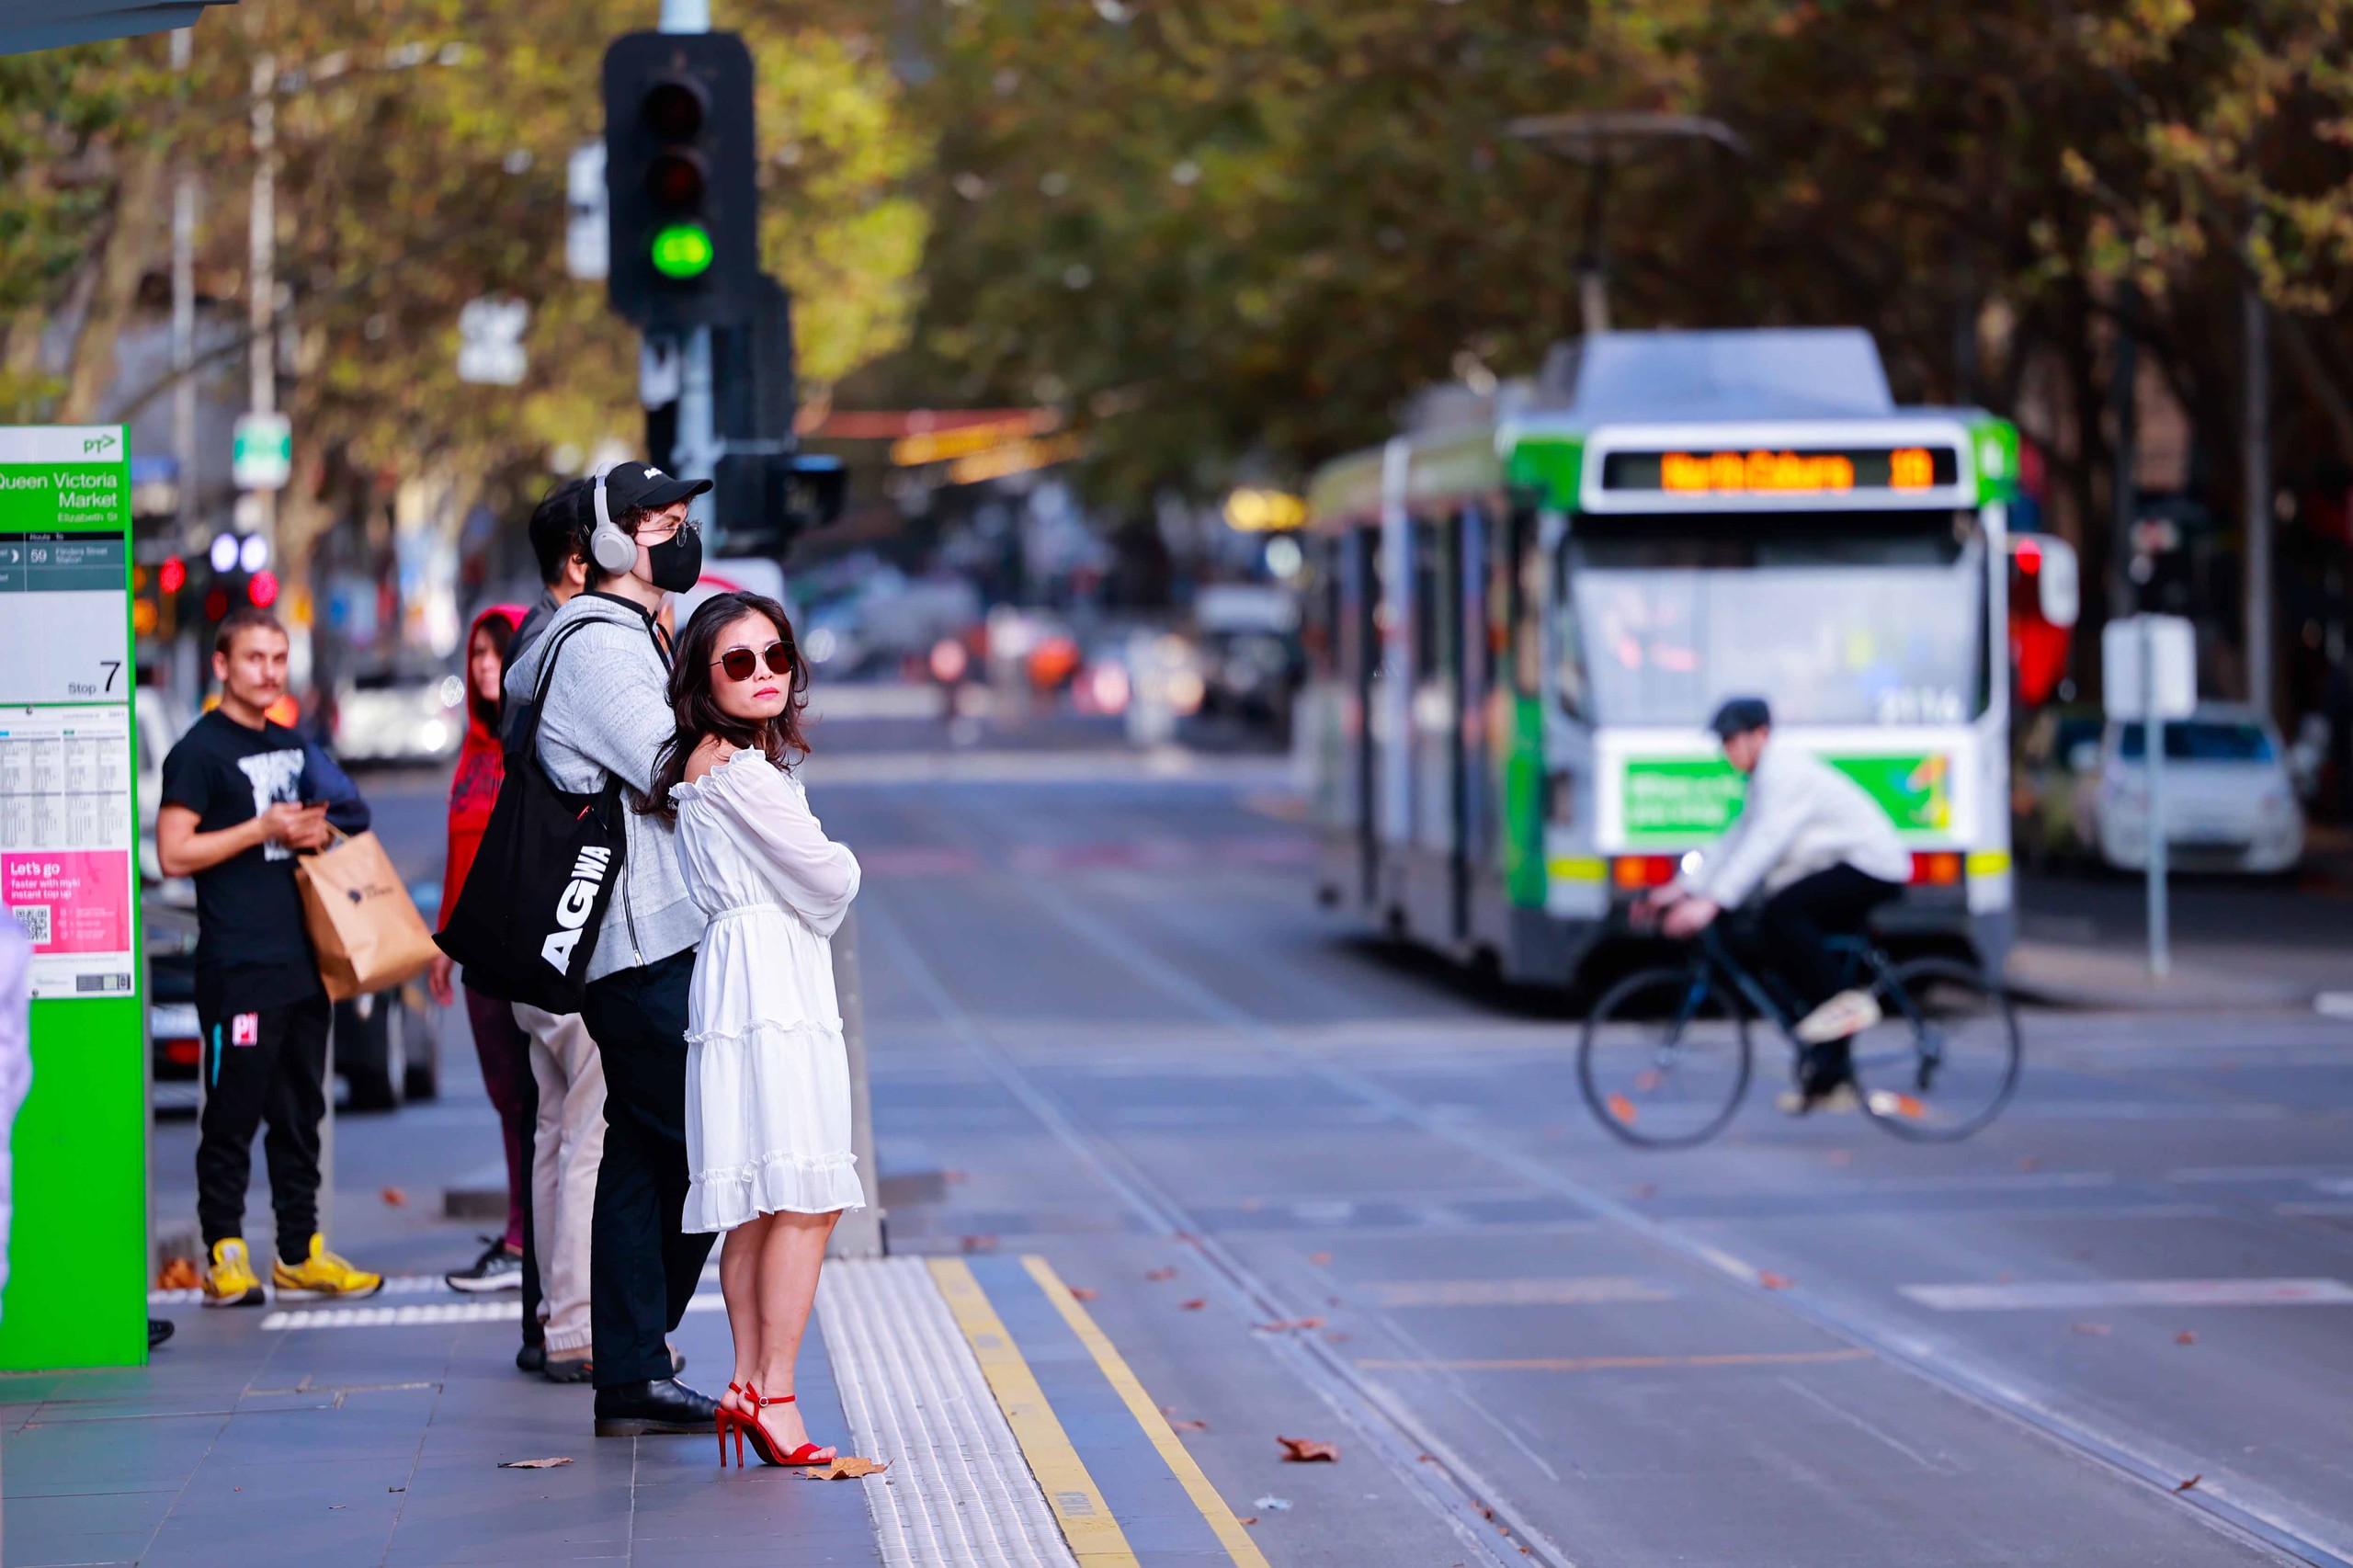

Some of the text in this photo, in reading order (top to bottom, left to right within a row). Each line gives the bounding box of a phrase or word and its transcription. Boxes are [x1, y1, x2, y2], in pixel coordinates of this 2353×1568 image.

[53, 472, 118, 488] Victoria
[59, 491, 118, 508] Market
[57, 511, 118, 522] Elizabeth St
[30, 549, 47, 563] 59
[68, 660, 121, 696] Stop 7
[10, 861, 61, 878] Let's go
[11, 879, 38, 889] faster
[40, 879, 59, 889] with
[11, 889, 72, 900] instant top up
[540, 845, 612, 977] AGWA
